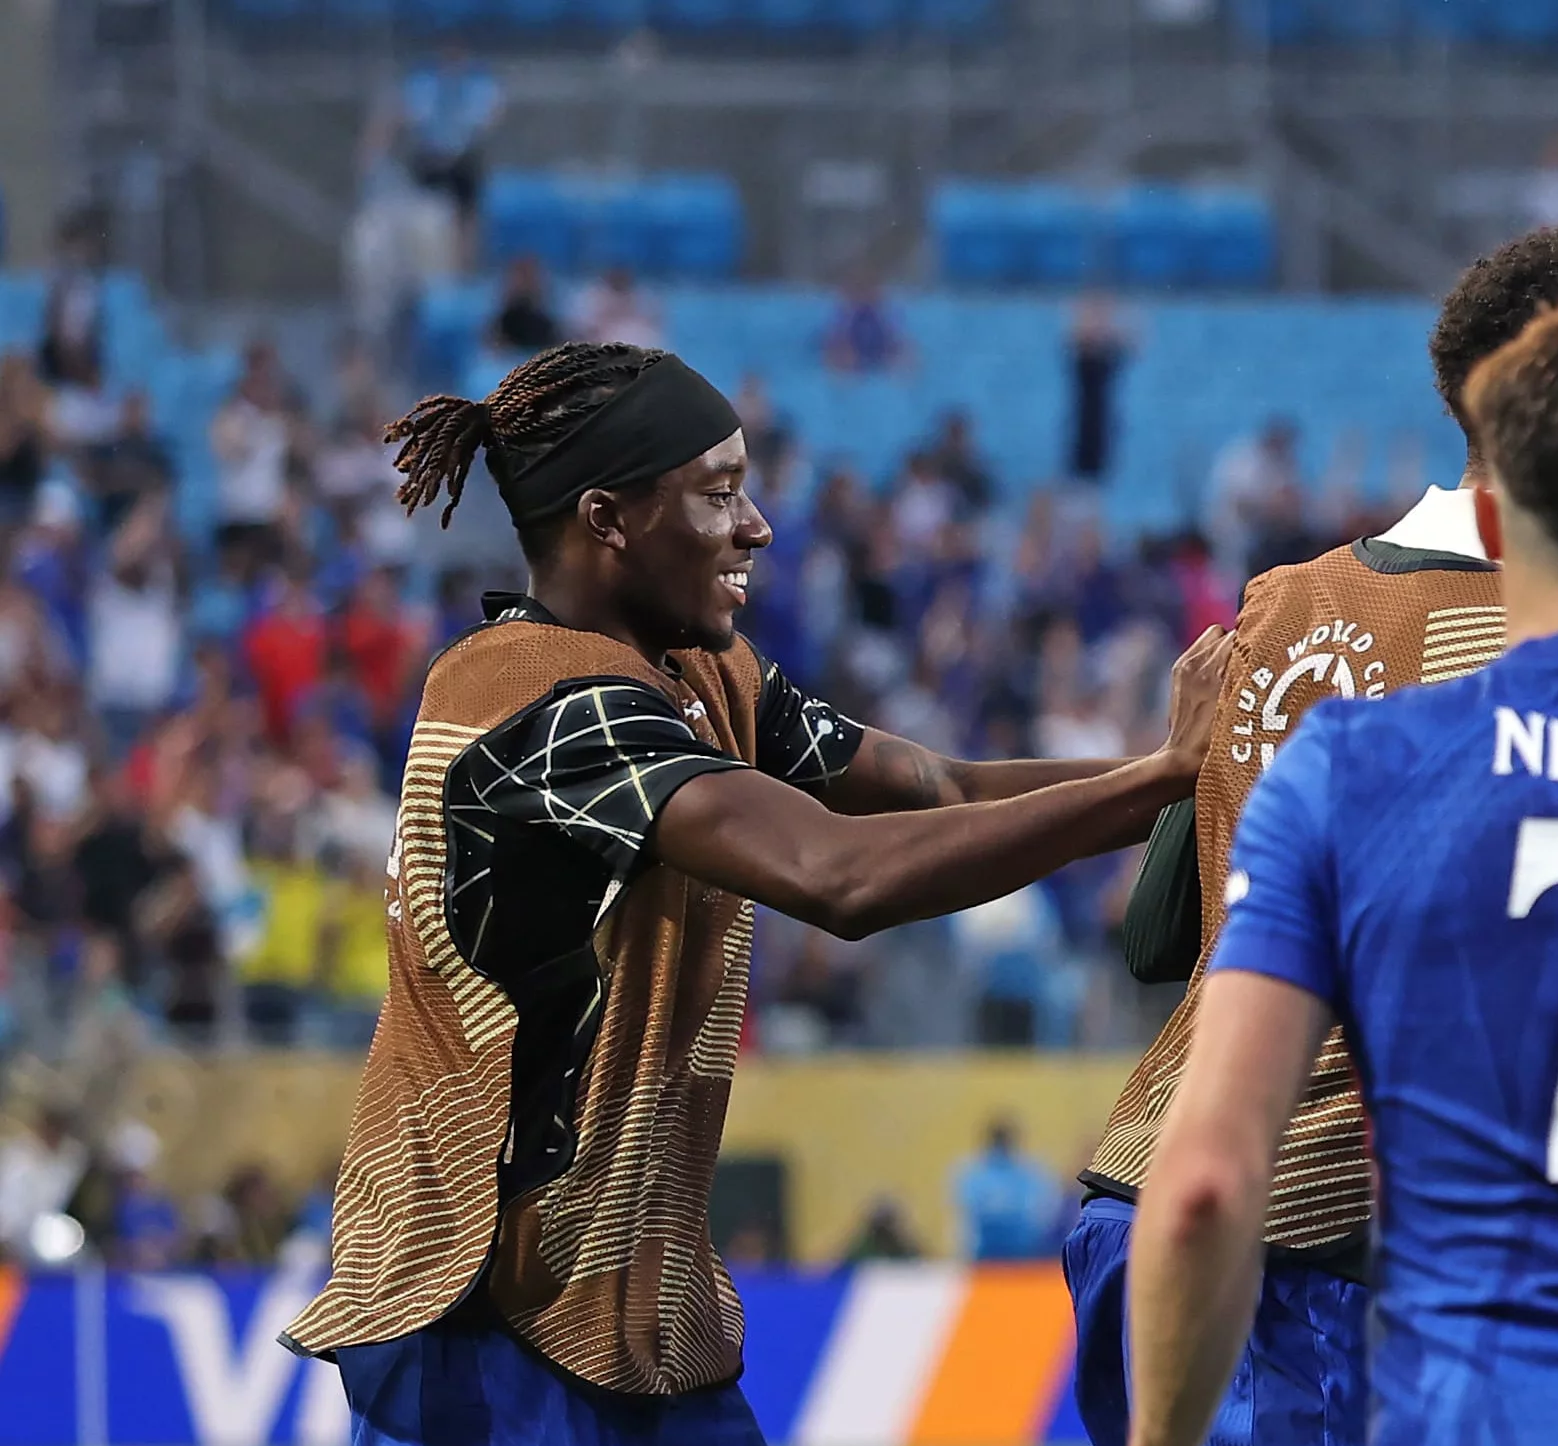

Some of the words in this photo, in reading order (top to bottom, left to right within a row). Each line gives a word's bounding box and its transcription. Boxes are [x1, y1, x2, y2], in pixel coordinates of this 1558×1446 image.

[1231, 667, 1274, 763] CLUB
[1287, 620, 1374, 662] WORLD
[1364, 661, 1385, 701] CU
